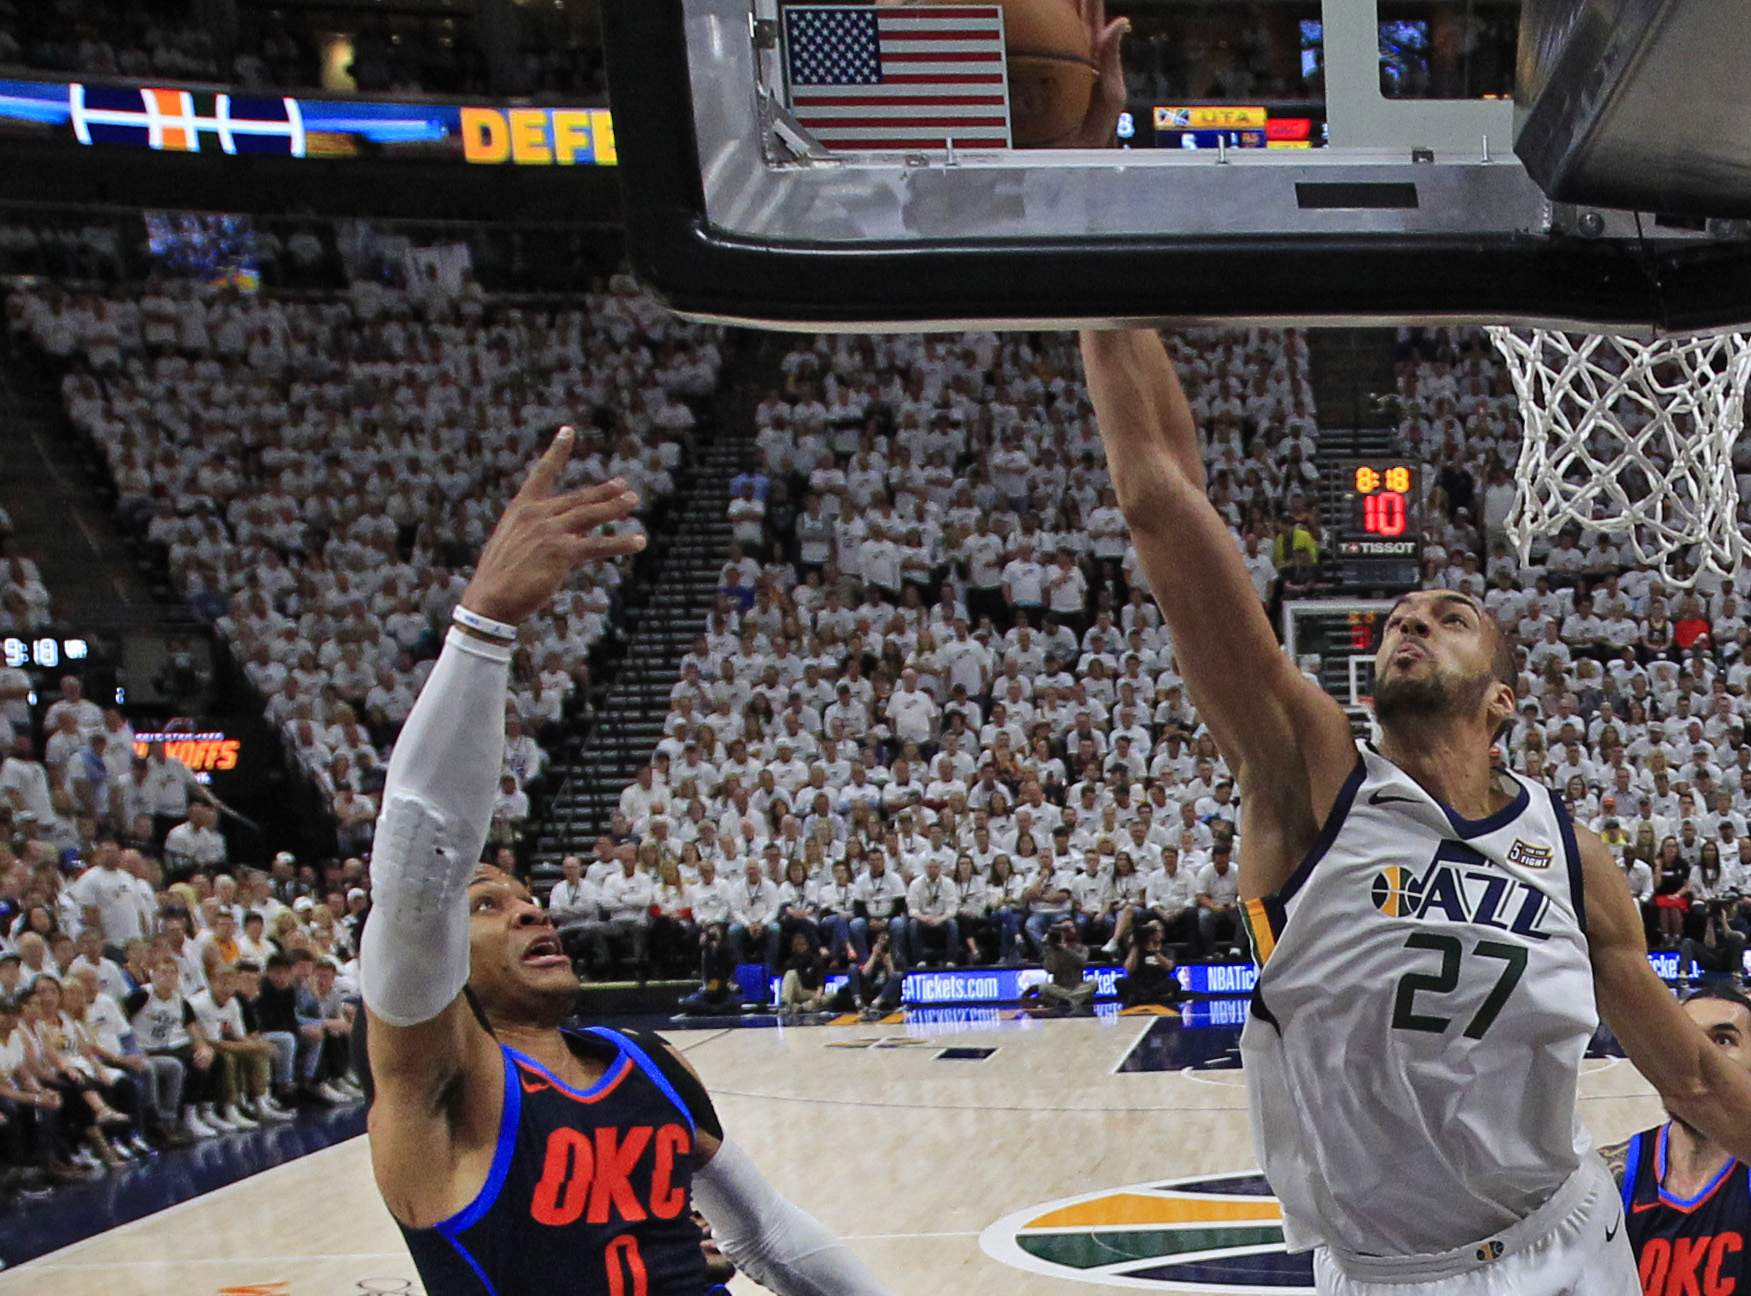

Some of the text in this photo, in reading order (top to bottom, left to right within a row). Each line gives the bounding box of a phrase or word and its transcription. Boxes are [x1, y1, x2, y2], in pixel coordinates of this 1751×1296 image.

[1201, 110, 1250, 122] UTA
[1355, 466, 1410, 494] 8:18
[1364, 492, 1406, 536] 10
[1360, 542, 1416, 554] TISSOT
[1392, 933, 1529, 1040] 27
[531, 1122, 691, 1226] OKC
